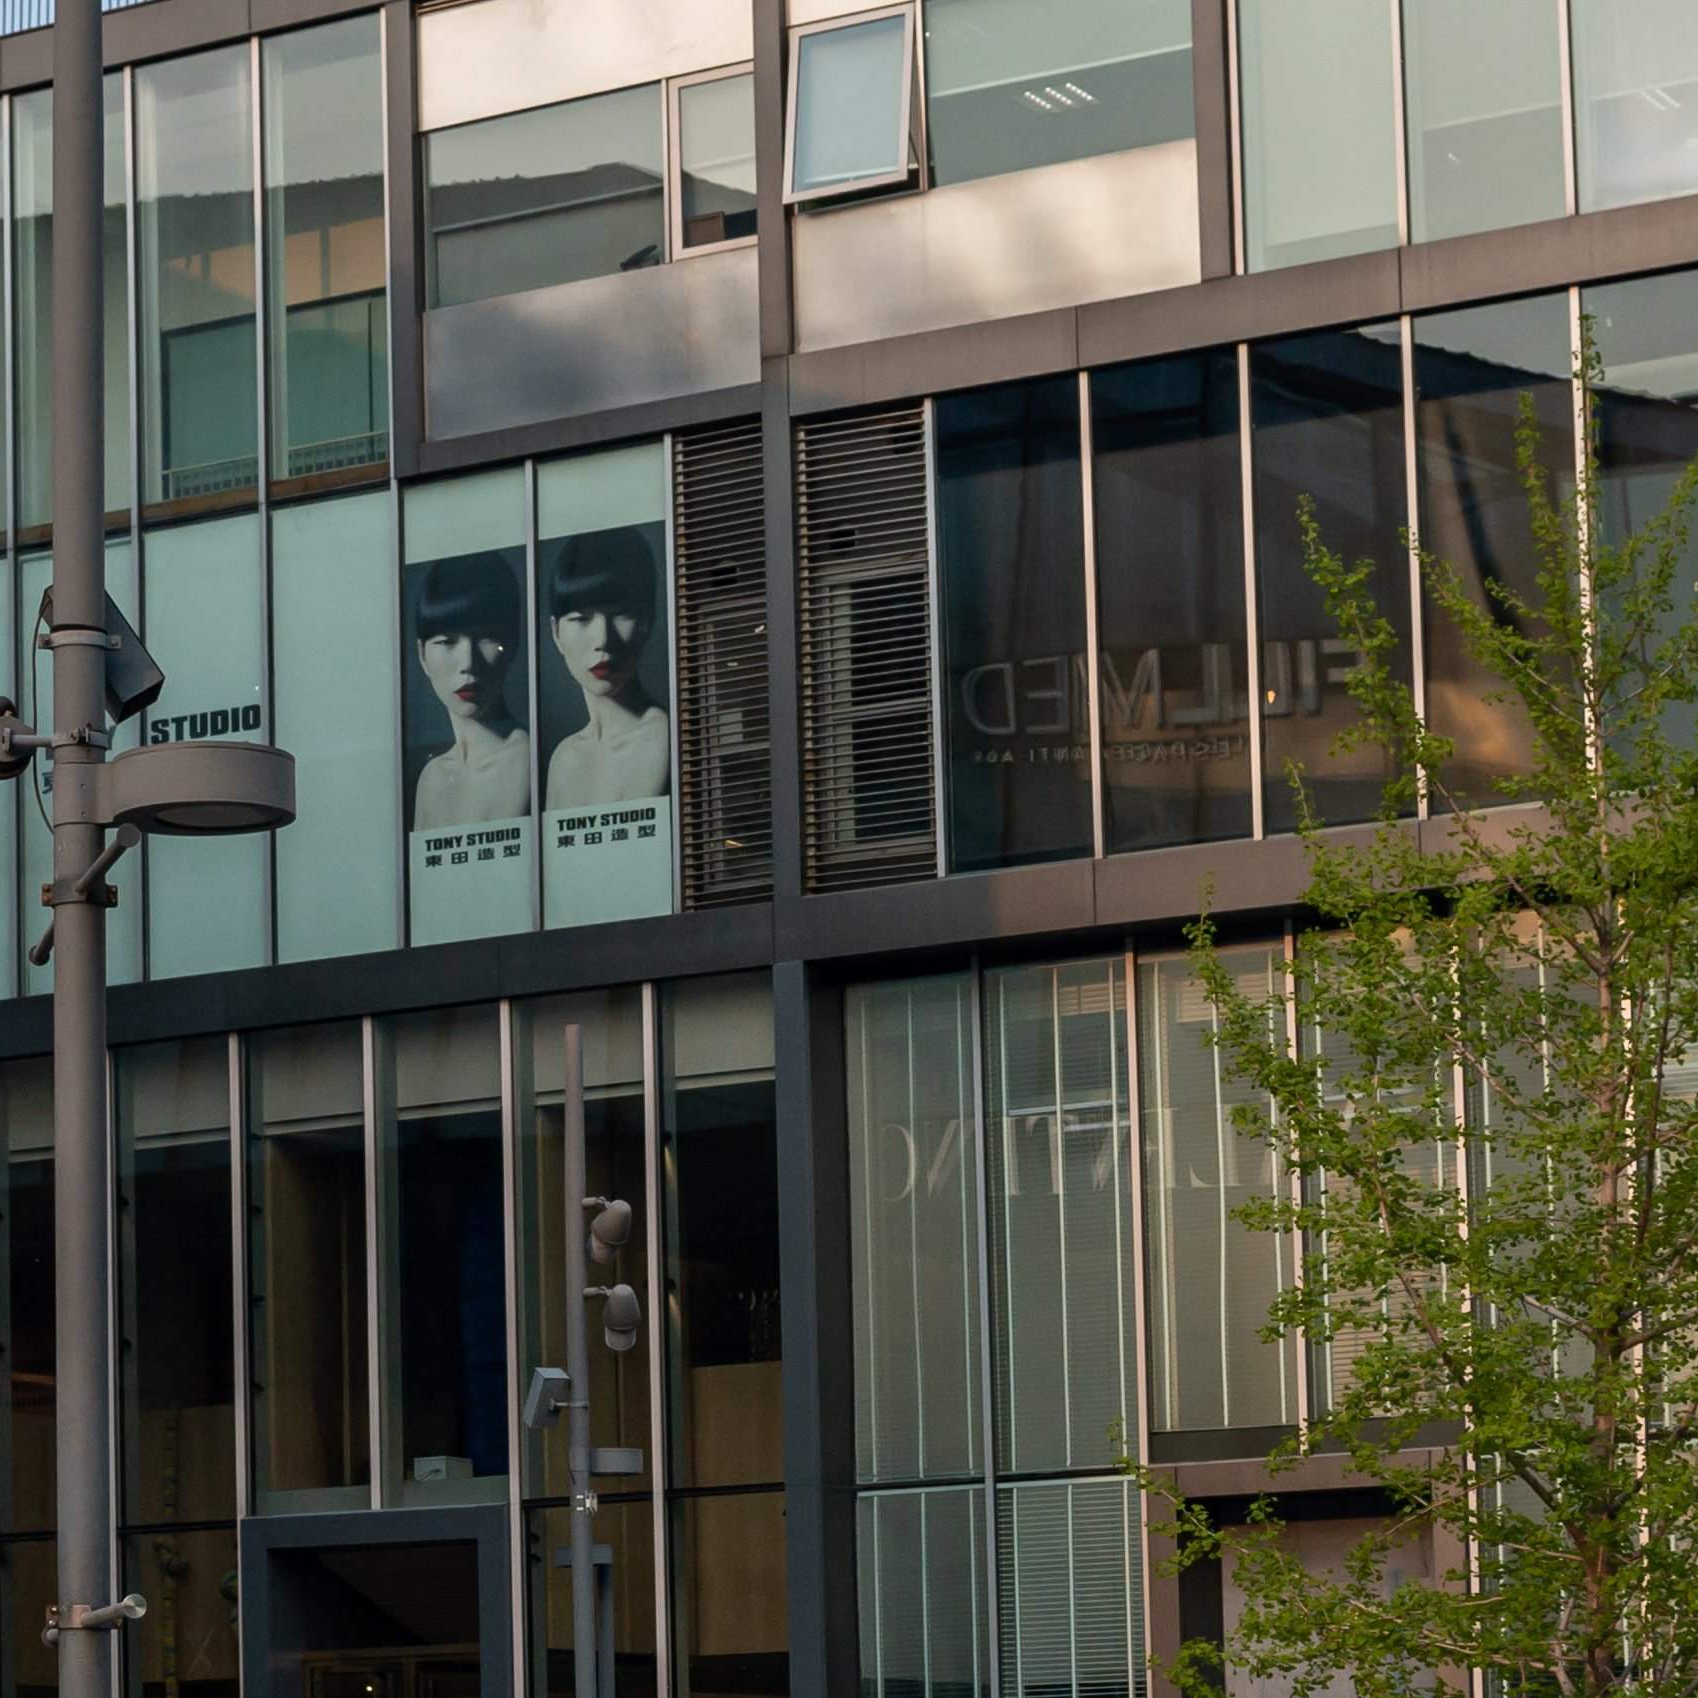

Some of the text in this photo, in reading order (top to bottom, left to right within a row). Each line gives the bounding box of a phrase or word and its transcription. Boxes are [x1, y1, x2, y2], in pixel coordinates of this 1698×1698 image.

[150, 703, 261, 744] STUDIO
[556, 807, 657, 832] TONY STUDIO
[424, 827, 521, 852] TONY STUDIO
[556, 823, 657, 849] 東田造型
[424, 843, 522, 868] 東田造型
